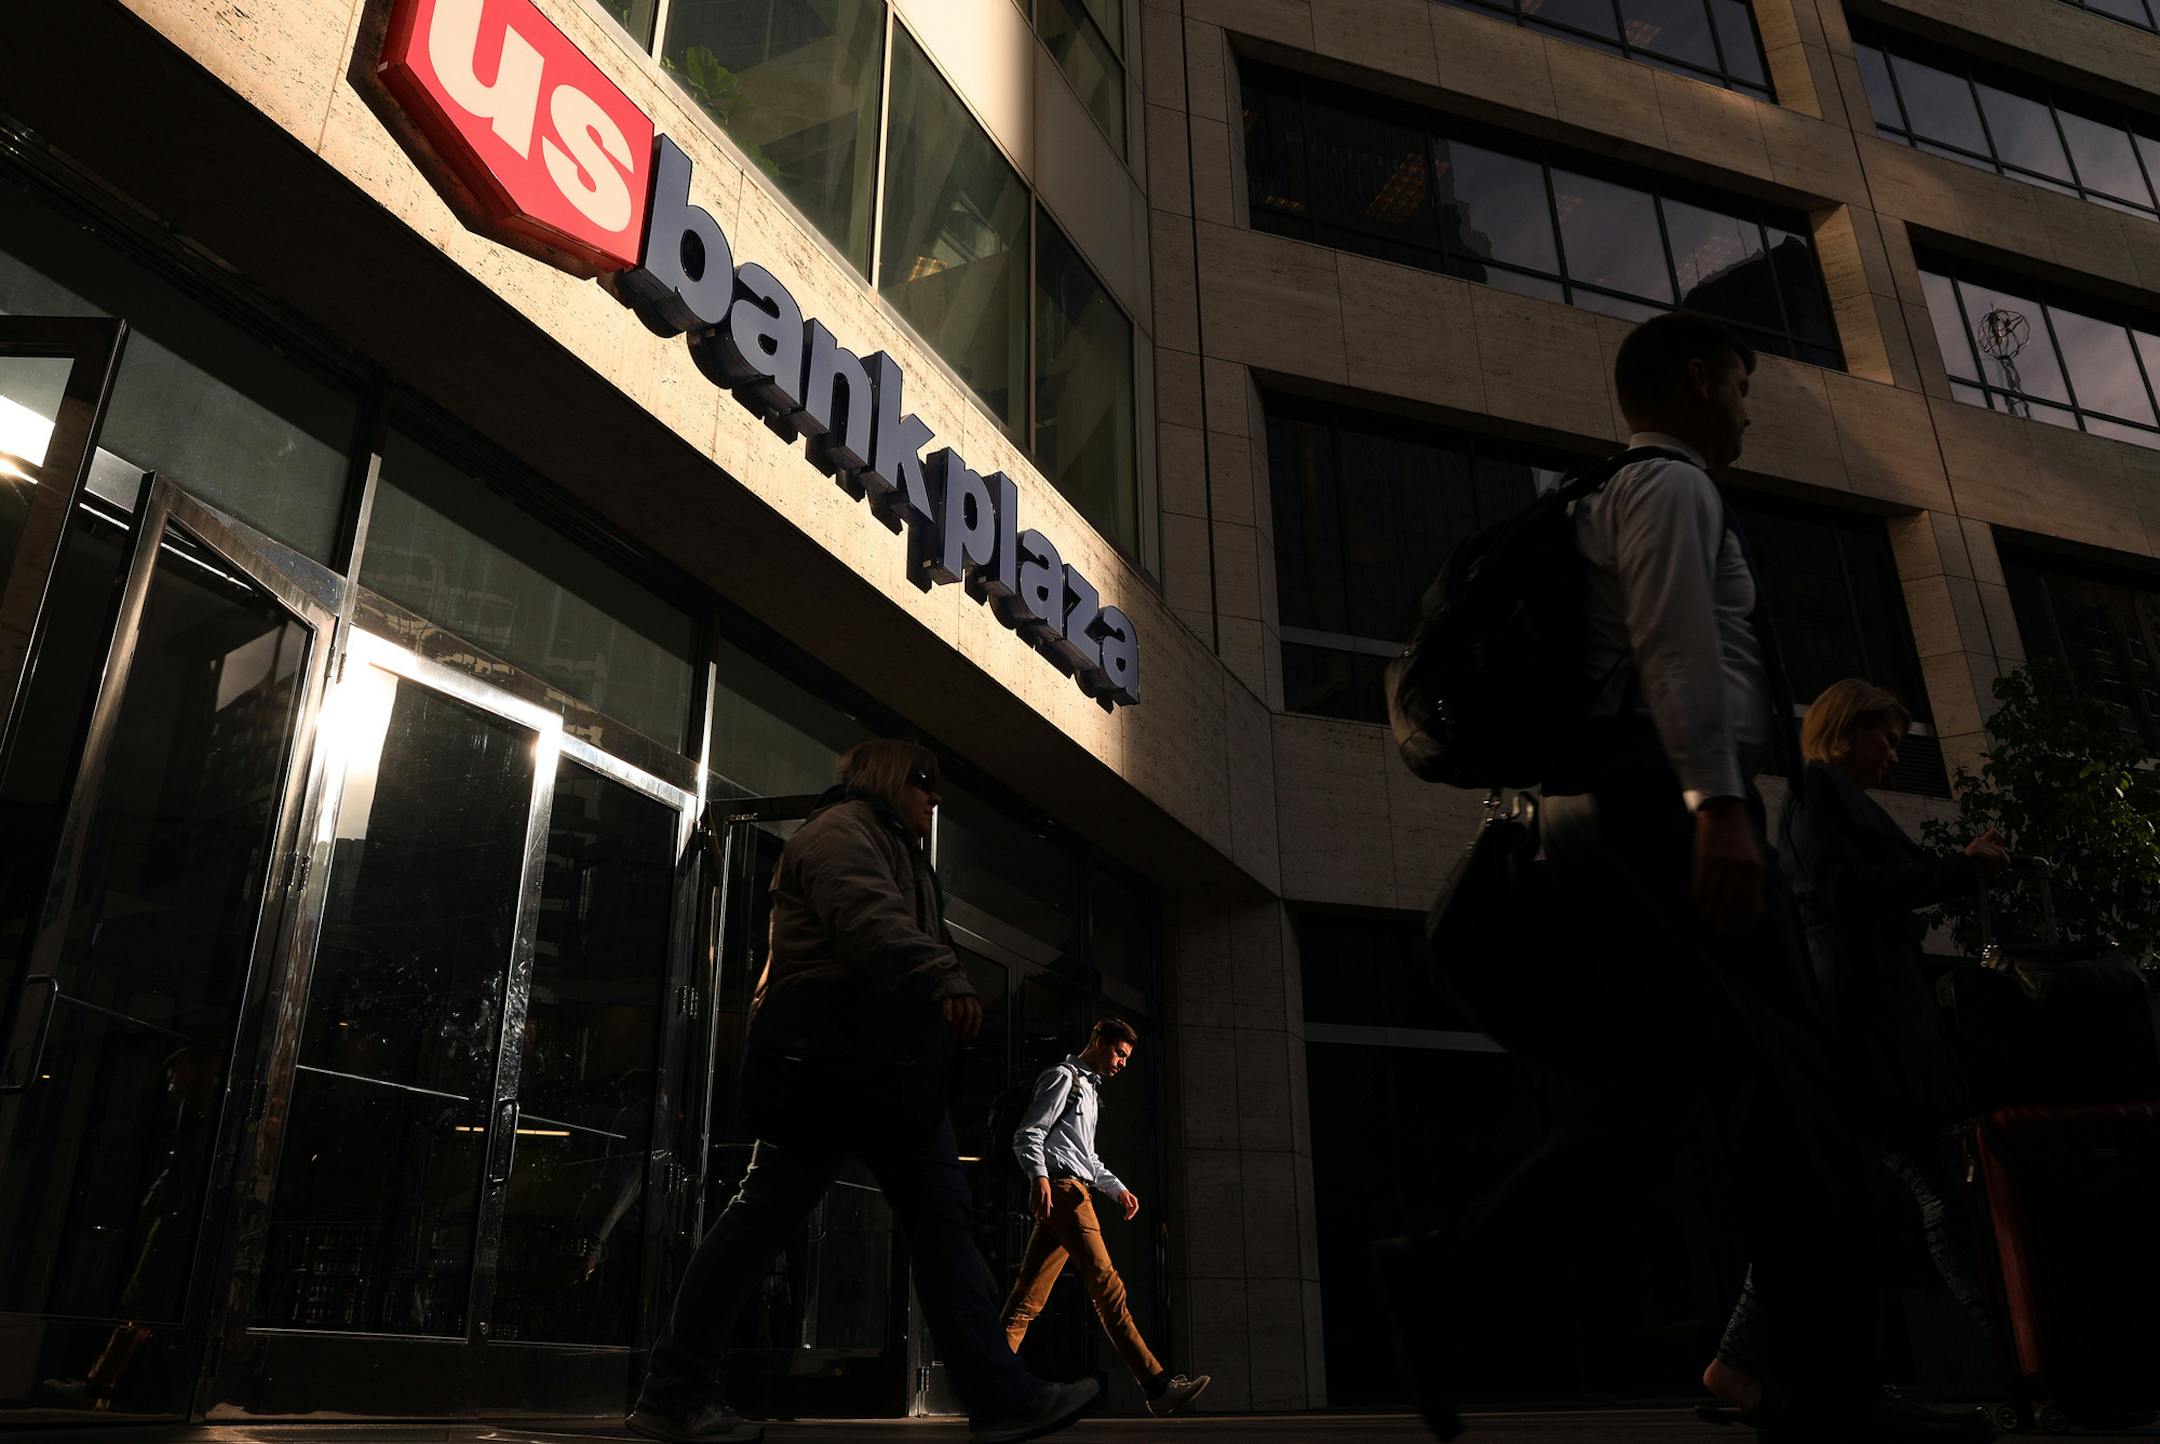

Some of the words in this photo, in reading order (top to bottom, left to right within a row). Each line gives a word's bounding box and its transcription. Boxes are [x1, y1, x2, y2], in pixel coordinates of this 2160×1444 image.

[428, 0, 635, 233] us
[644, 132, 936, 522] bank
[937, 446, 1141, 706] plaza
